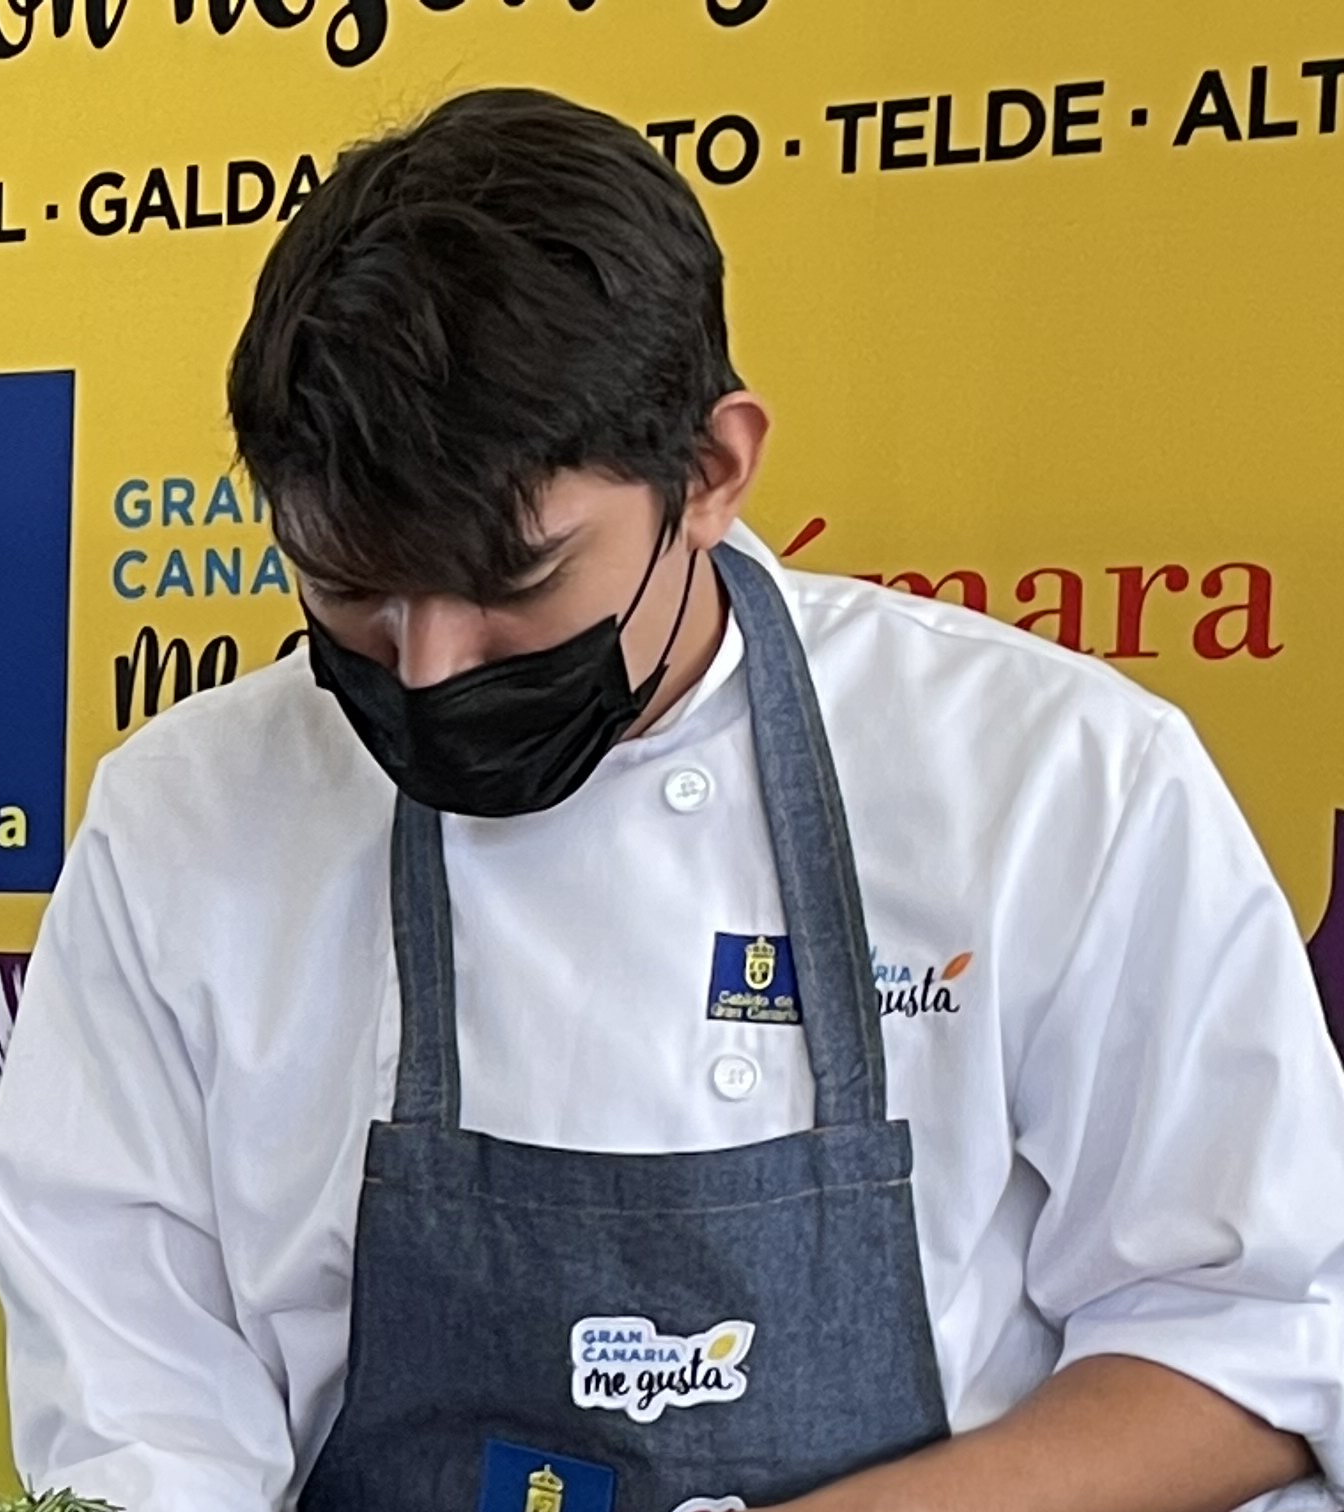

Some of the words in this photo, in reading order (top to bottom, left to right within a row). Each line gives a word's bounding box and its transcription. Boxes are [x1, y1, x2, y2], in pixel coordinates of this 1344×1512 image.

[79, 154, 320, 238] GALDA
[646, 114, 760, 185] TO
[825, 81, 1105, 174] TELDE
[114, 476, 262, 528] GRA
[582, 1329, 643, 1345] GRAN
[582, 1347, 681, 1364] CANARIA
[583, 1366, 630, 1397] me
[637, 1347, 734, 1410] gusta
